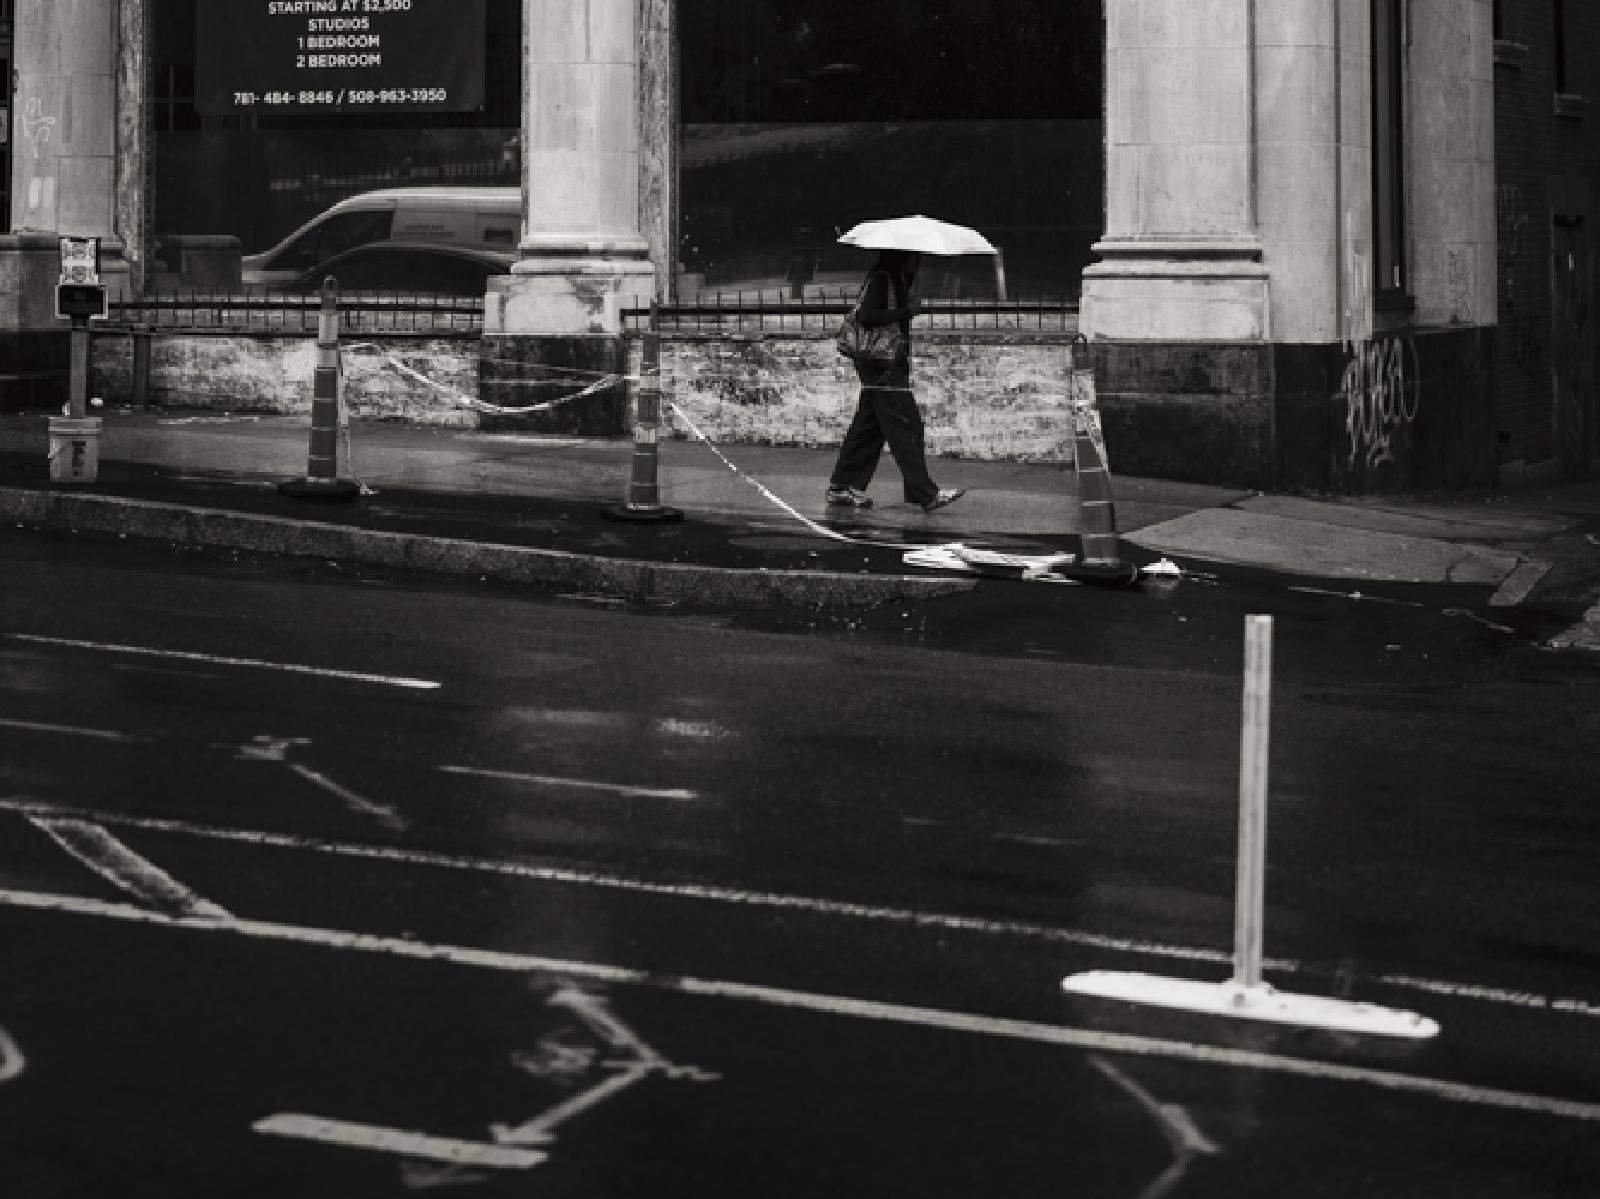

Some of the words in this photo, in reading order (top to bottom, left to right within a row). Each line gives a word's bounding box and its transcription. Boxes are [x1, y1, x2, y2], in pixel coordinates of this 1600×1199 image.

[268, 0, 337, 15] STARTING
[340, 0, 359, 12] AT
[308, 16, 370, 31] STUDIOS
[306, 34, 380, 50] BEDROOM
[296, 55, 306, 68] 2
[308, 52, 382, 68] BEDROOM
